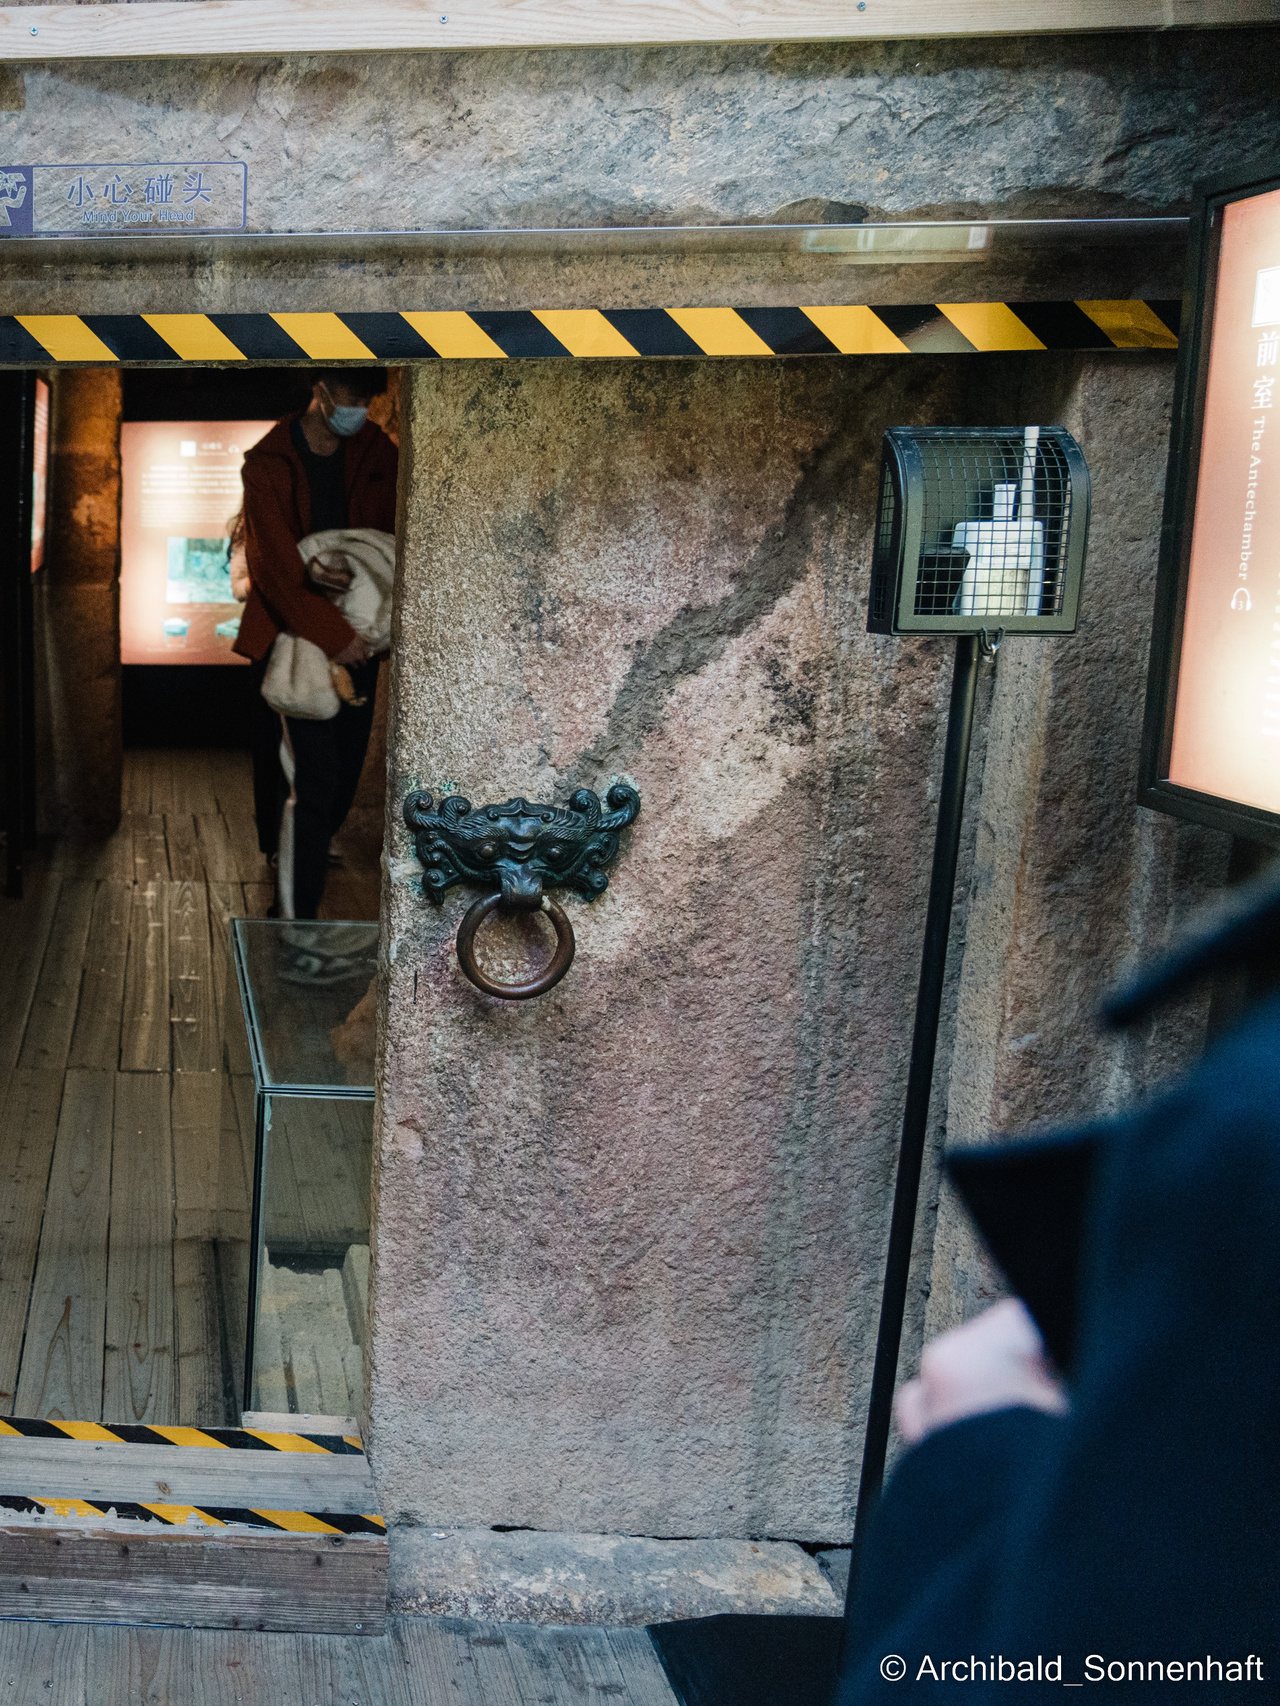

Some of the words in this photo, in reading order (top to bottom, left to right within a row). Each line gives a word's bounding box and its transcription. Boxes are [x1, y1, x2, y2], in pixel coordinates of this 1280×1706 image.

[67, 173, 212, 206] 小心碰头
[82, 209, 118, 223] Mind
[122, 209, 154, 222] Your
[158, 208, 195, 222] Head
[1250, 331, 1280, 409] 前室
[1251, 415, 1265, 451] The
[1238, 455, 1262, 580] Antechamber
